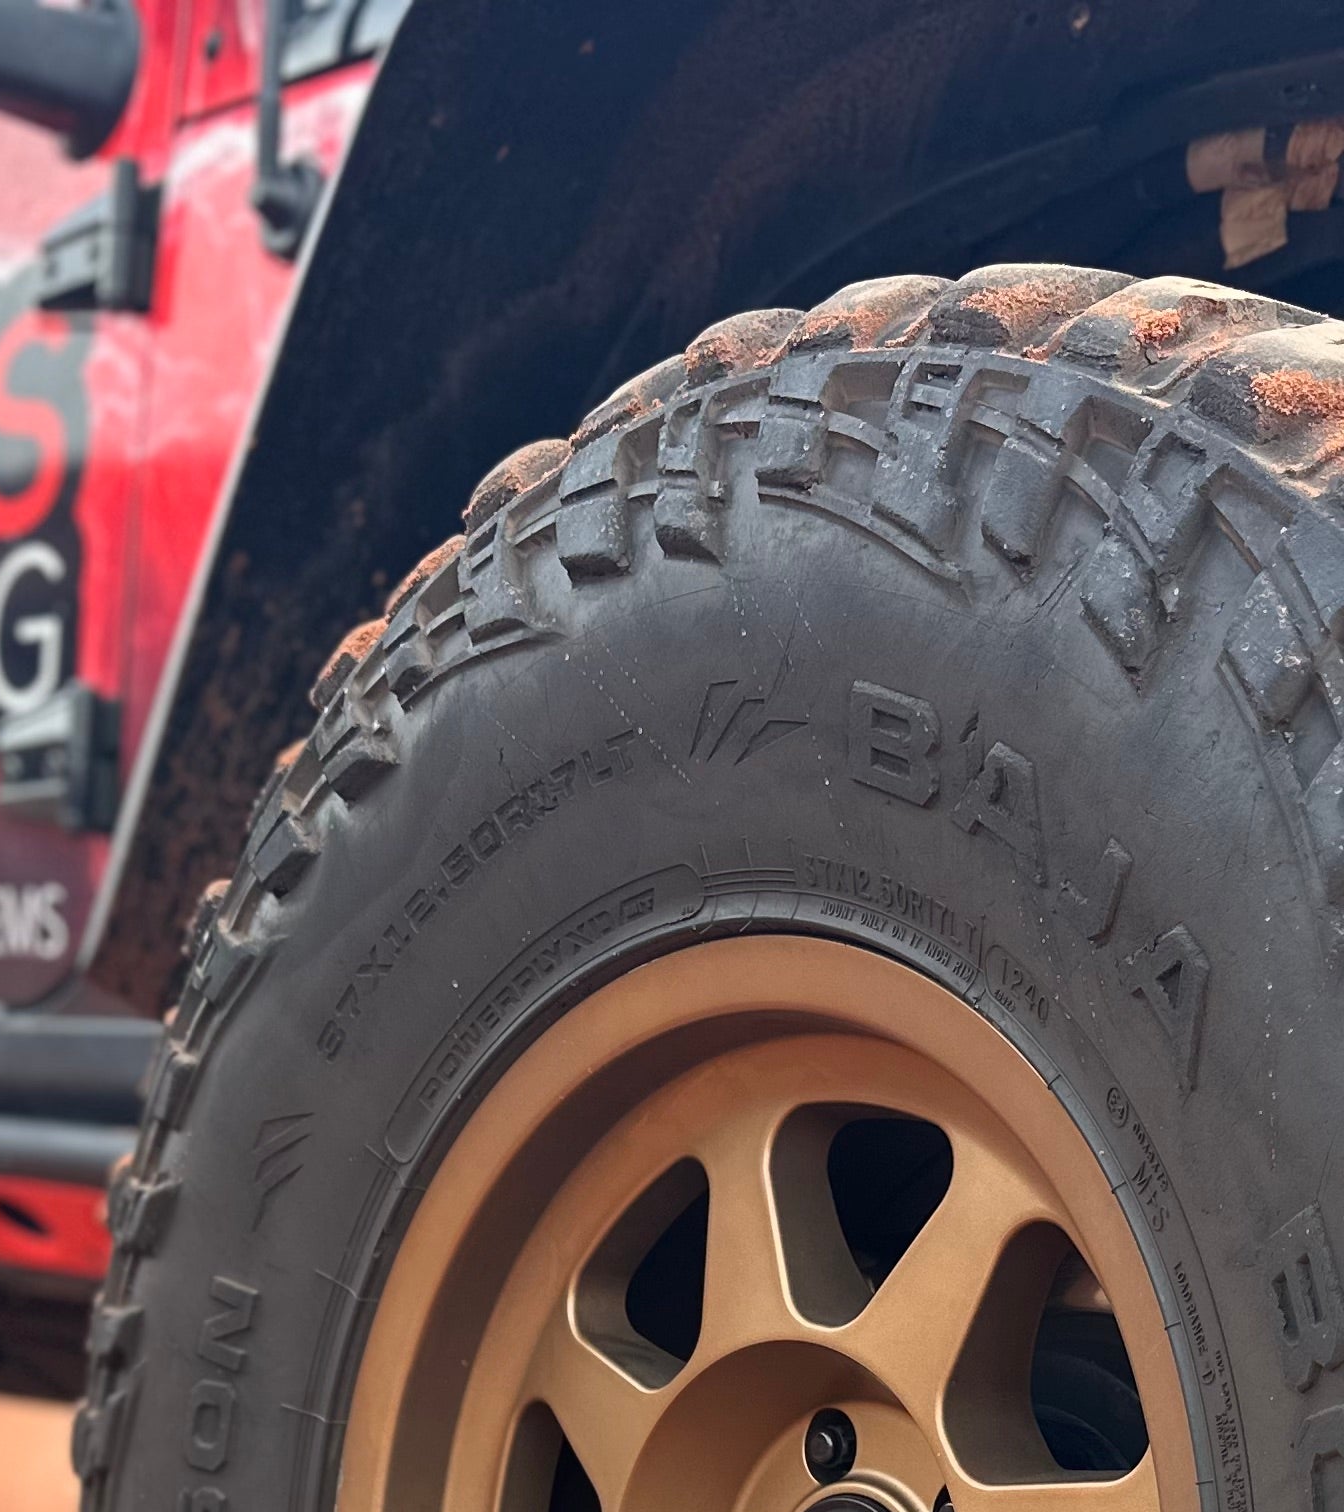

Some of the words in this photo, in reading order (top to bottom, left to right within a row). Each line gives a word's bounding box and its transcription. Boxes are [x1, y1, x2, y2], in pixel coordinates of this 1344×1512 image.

[851, 678, 1216, 1093] BAJA
[819, 900, 856, 922] MOUNT
[892, 925, 906, 942] ON
[1001, 957, 1051, 1024] 1240
